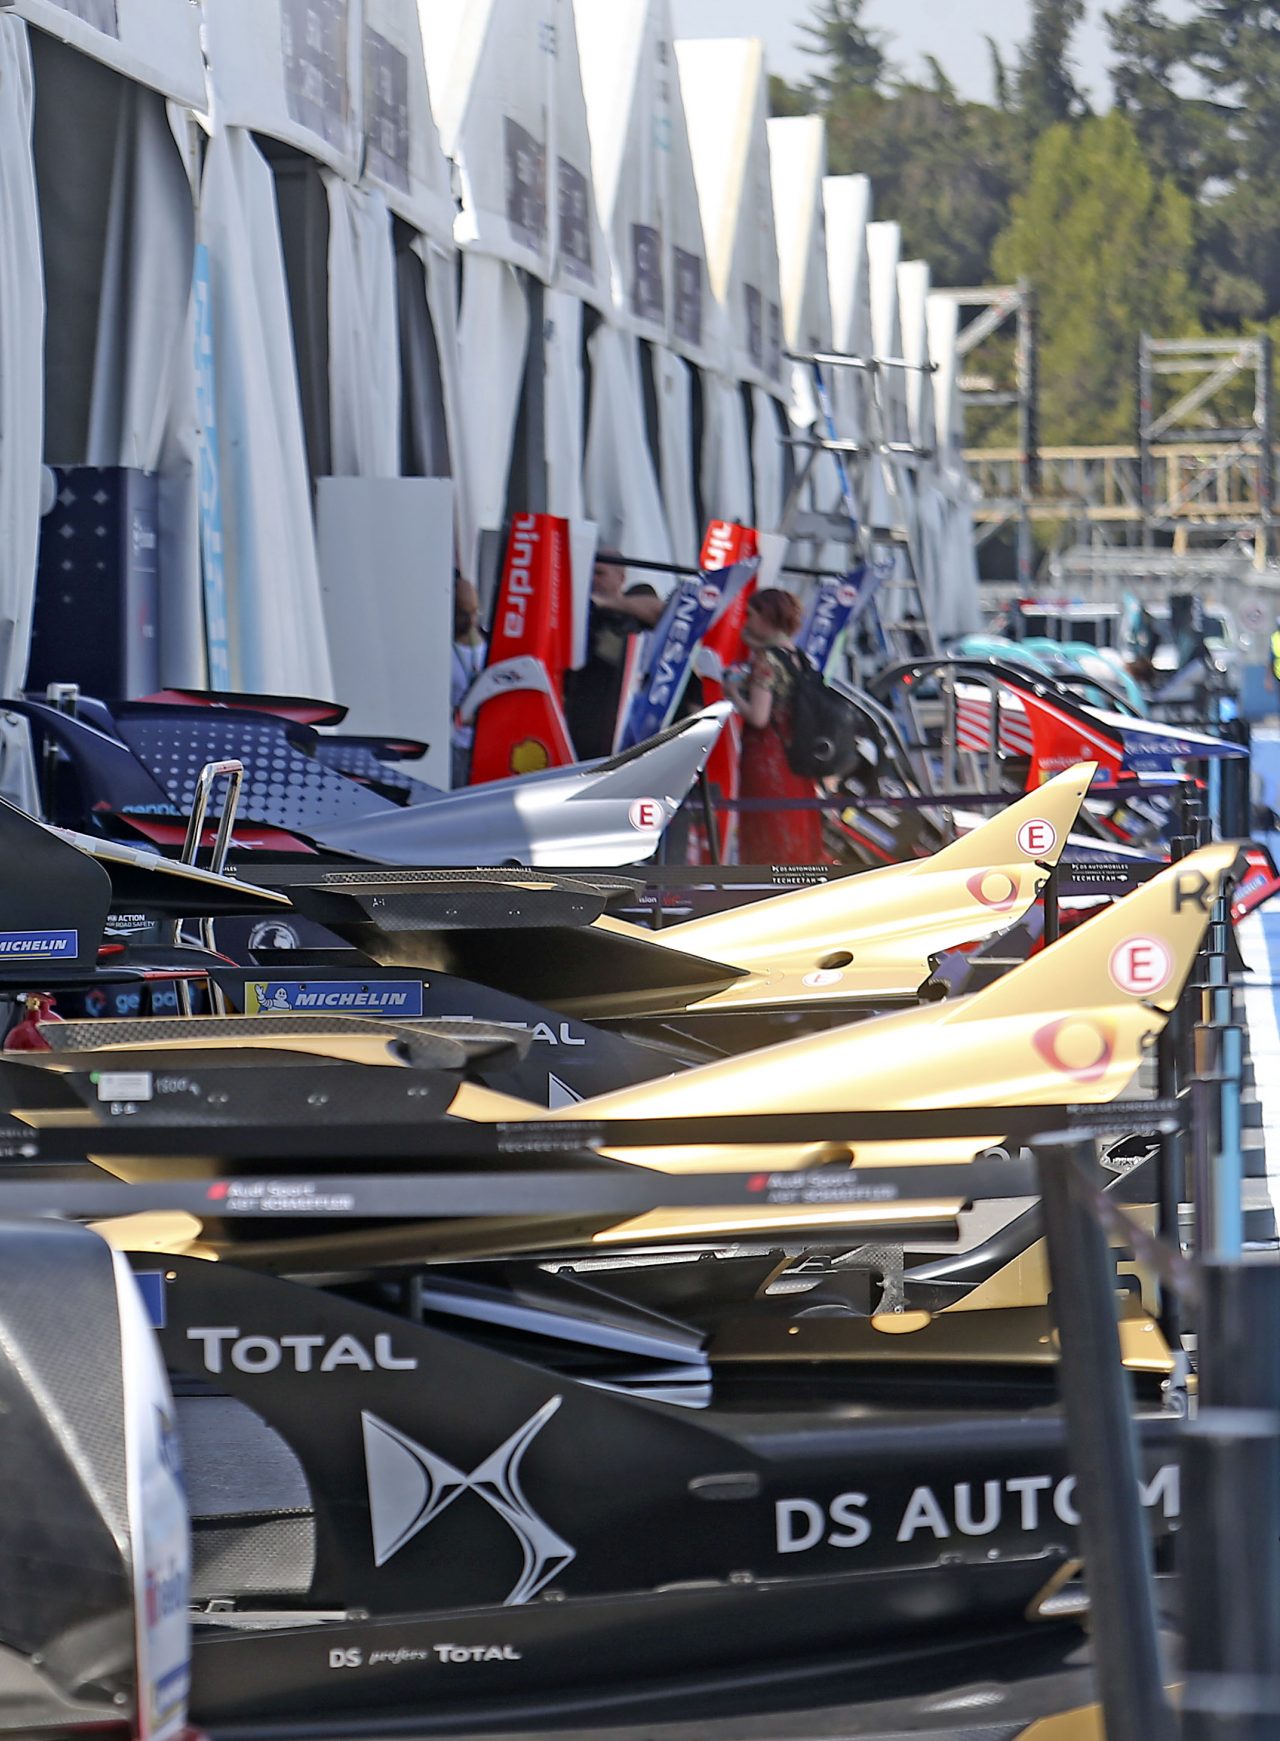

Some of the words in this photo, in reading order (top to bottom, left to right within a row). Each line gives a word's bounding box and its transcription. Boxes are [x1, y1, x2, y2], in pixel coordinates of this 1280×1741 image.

[639, 804, 654, 827] E
[1028, 824, 1045, 849] E
[1173, 869, 1210, 914] R
[118, 914, 146, 922] ACTION
[1129, 947, 1157, 982] E
[295, 992, 408, 1007] MICHELIN
[186, 1326, 418, 1374] TOTAL
[774, 1492, 872, 1554] DS
[329, 1648, 362, 1669] DS
[433, 1643, 522, 1663] TOTAL
